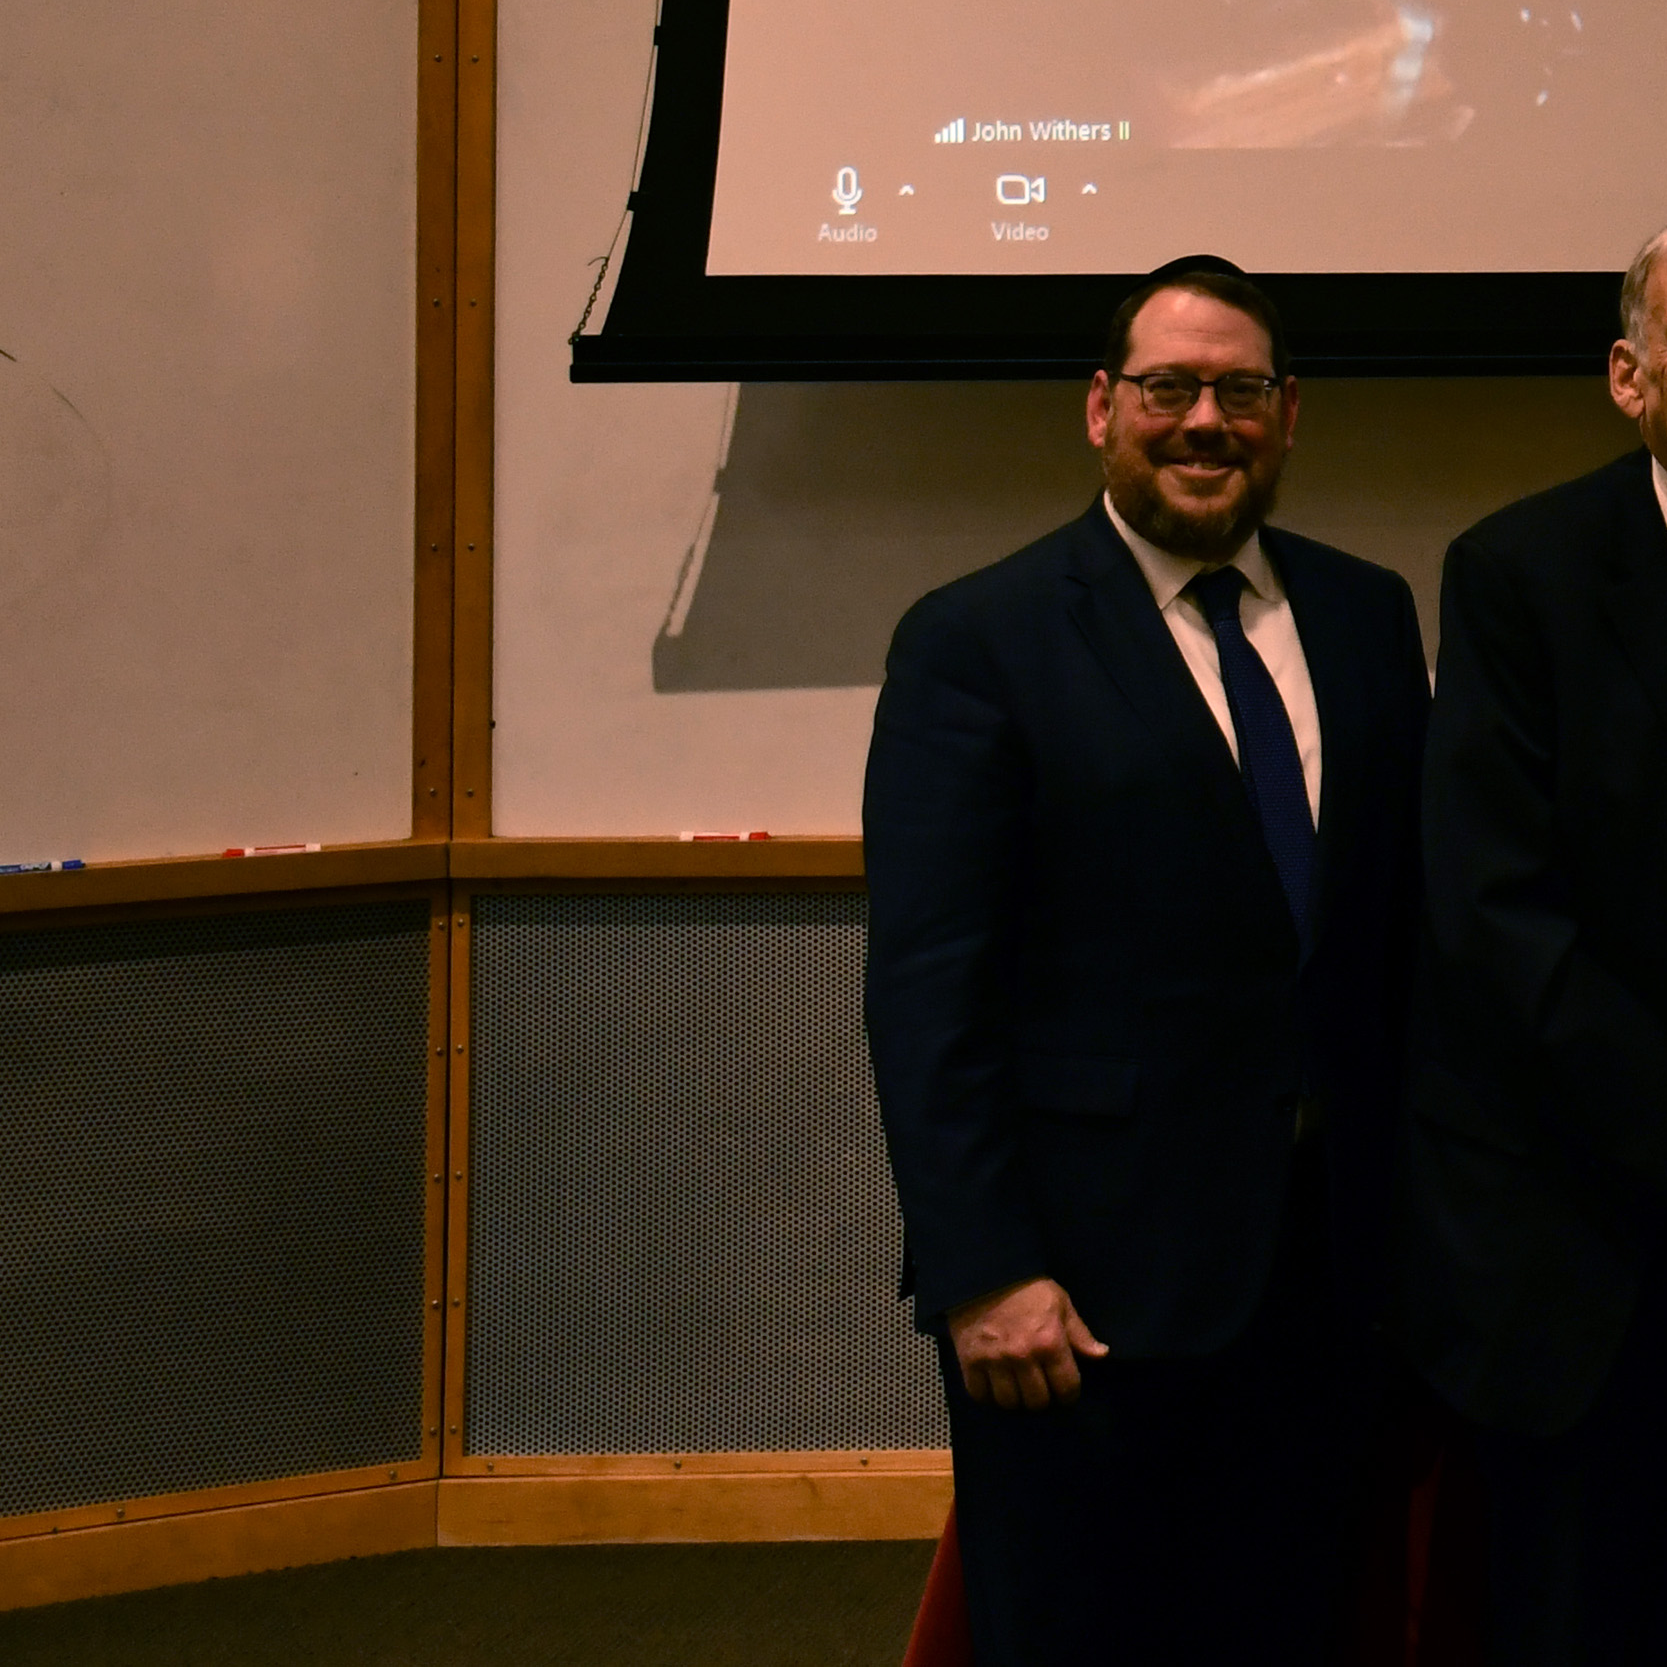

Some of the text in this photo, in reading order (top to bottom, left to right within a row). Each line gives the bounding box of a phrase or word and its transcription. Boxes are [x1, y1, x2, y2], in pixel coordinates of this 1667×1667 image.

[971, 120, 1022, 141] John
[1029, 119, 1111, 141] Withers
[818, 223, 878, 242] Audio
[991, 222, 1049, 241] Video
